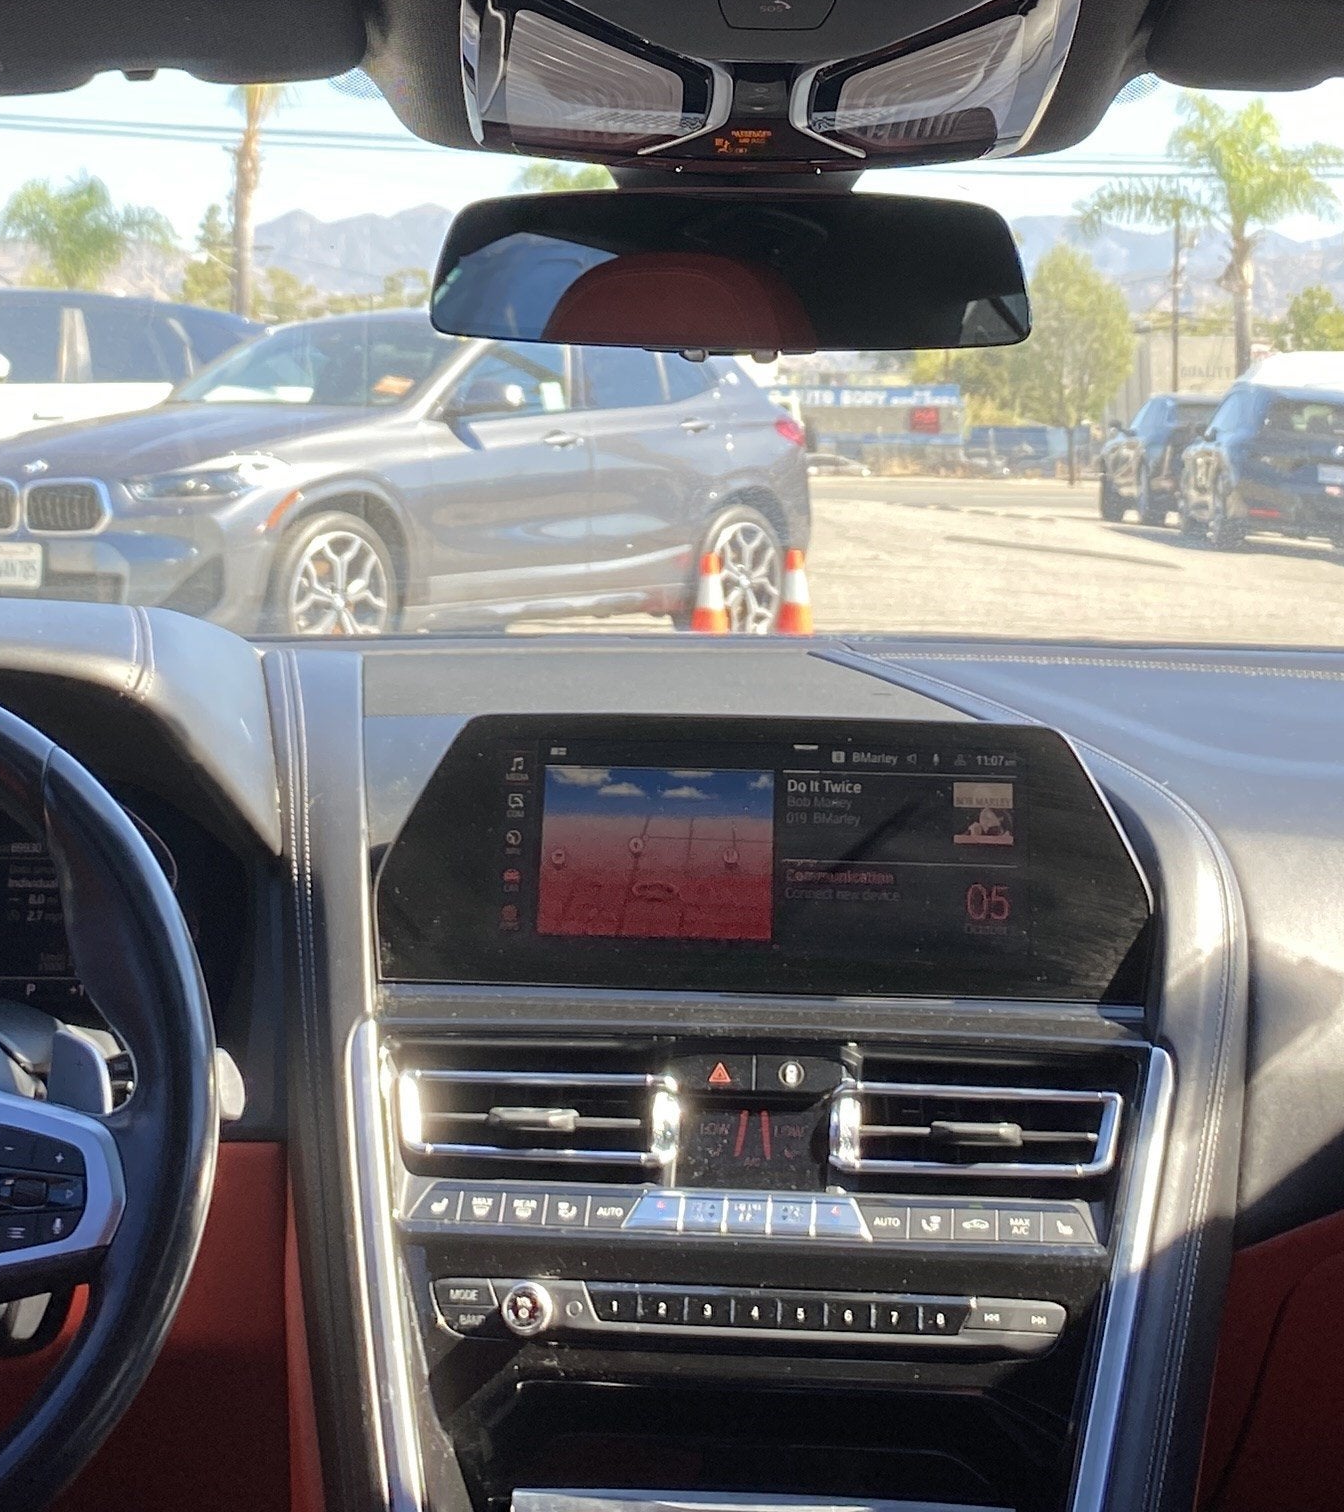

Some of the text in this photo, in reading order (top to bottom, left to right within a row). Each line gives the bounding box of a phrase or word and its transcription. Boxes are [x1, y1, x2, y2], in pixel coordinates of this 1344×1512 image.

[852, 751, 899, 766] BMarley
[976, 755, 1004, 766] 11:07
[787, 779, 862, 794] Do It Twice
[787, 796, 853, 811] Bob Marley
[975, 796, 1012, 808] MARLEY
[813, 813, 862, 826] BMarley
[785, 869, 895, 884] Communication
[785, 889, 900, 902] Connect new device
[967, 883, 1009, 920] 05
[26, 983, 37, 996] P
[513, 1199, 537, 1208] REAR
[596, 1206, 624, 1217] AUTO
[873, 1216, 901, 1227] AUTO
[1009, 1218, 1031, 1227] MAX
[1012, 1226, 1030, 1236] A/C
[449, 1289, 479, 1300] MODE
[611, 1300, 619, 1313] 1
[658, 1301, 667, 1314] 2
[703, 1303, 712, 1316] 3
[751, 1305, 760, 1317] 4
[796, 1307, 805, 1320] 5
[843, 1309, 853, 1321] 6
[891, 1311, 899, 1324] 7
[936, 1313, 946, 1326] 8
